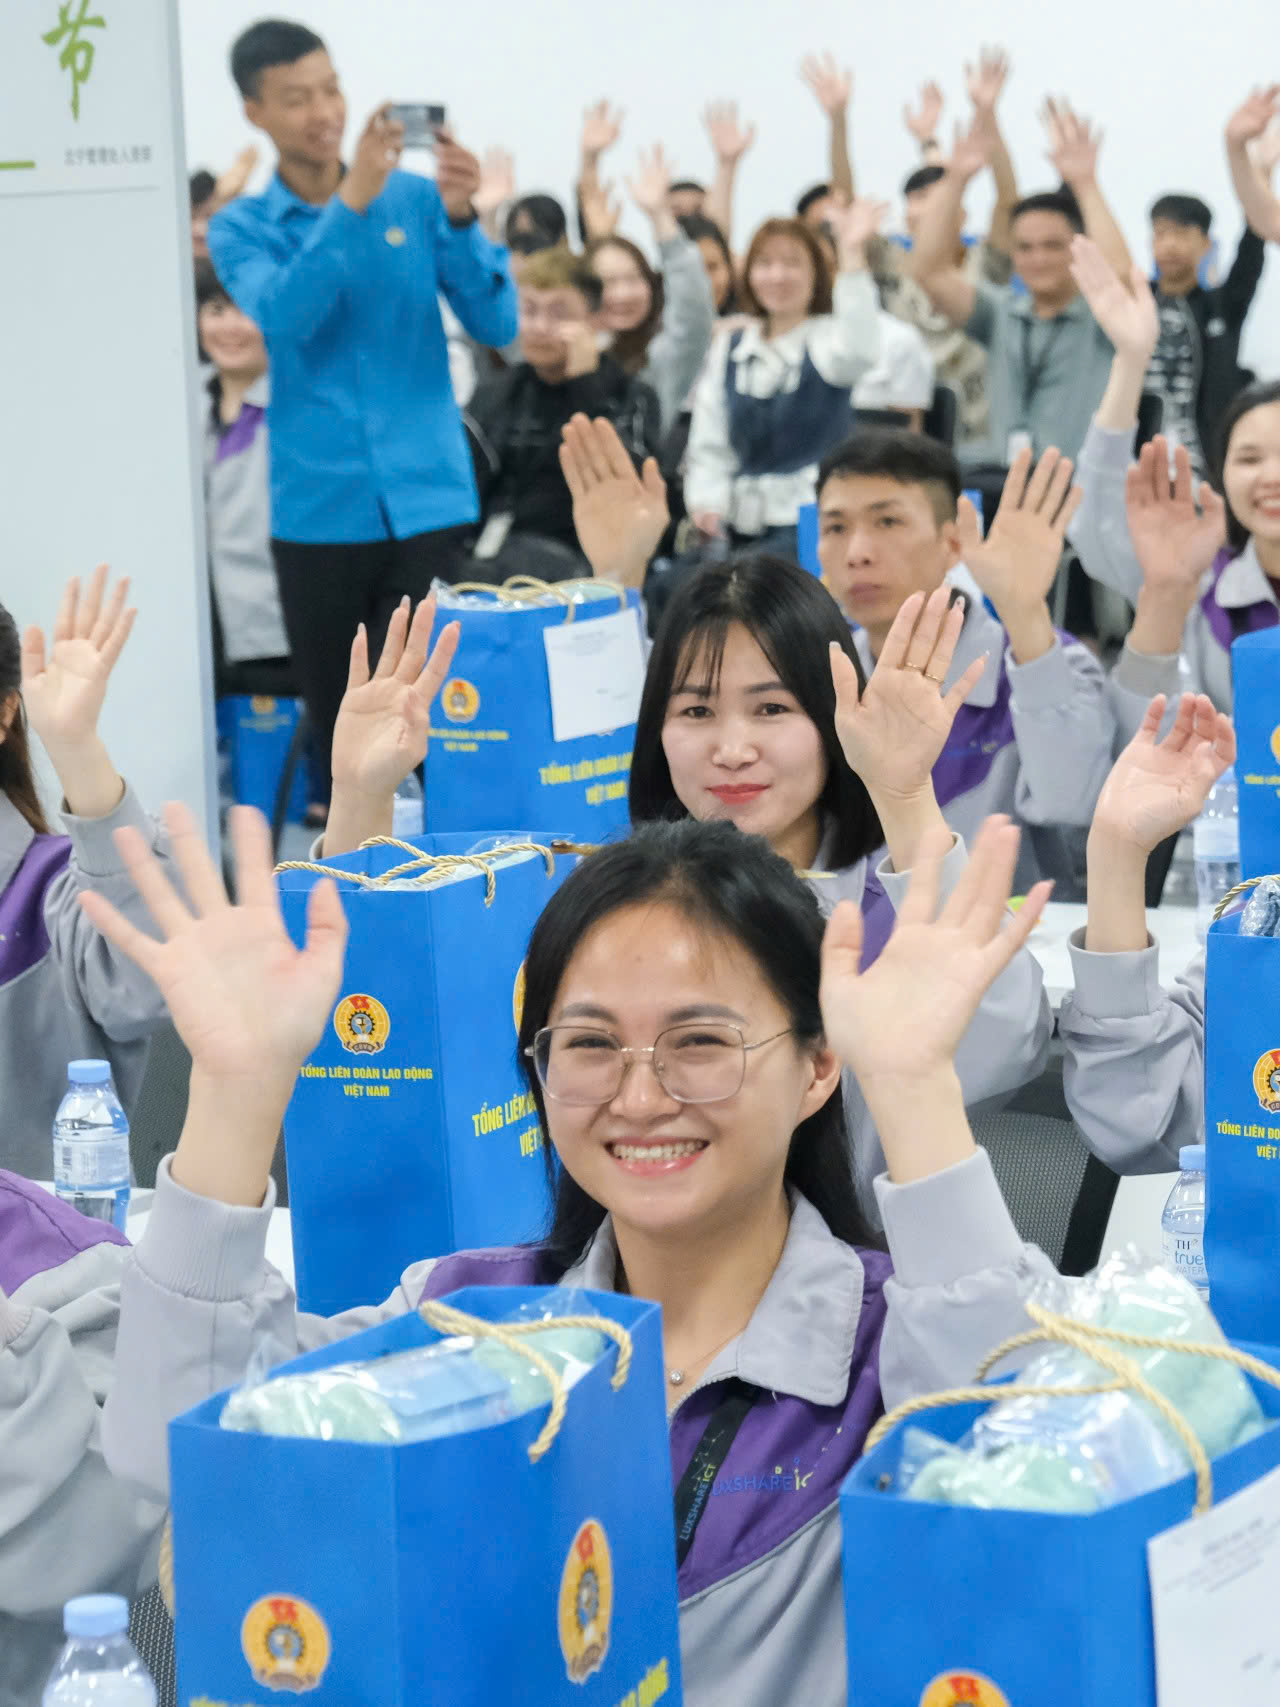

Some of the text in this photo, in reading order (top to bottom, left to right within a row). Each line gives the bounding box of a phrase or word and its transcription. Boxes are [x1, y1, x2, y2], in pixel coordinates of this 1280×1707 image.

[300, 1062, 433, 1082] TỔNG LIÊN ĐOÀN LAO ĐỘNG
[343, 1083, 391, 1099] VIỆT NAM
[472, 1101, 504, 1137] TỔNG
[1216, 1118, 1241, 1137] TỔNG
[1243, 1124, 1266, 1139] LIÊN
[1256, 1144, 1277, 1161] VIỆT
[1175, 1239, 1190, 1250] TH
[1175, 1250, 1204, 1266] true
